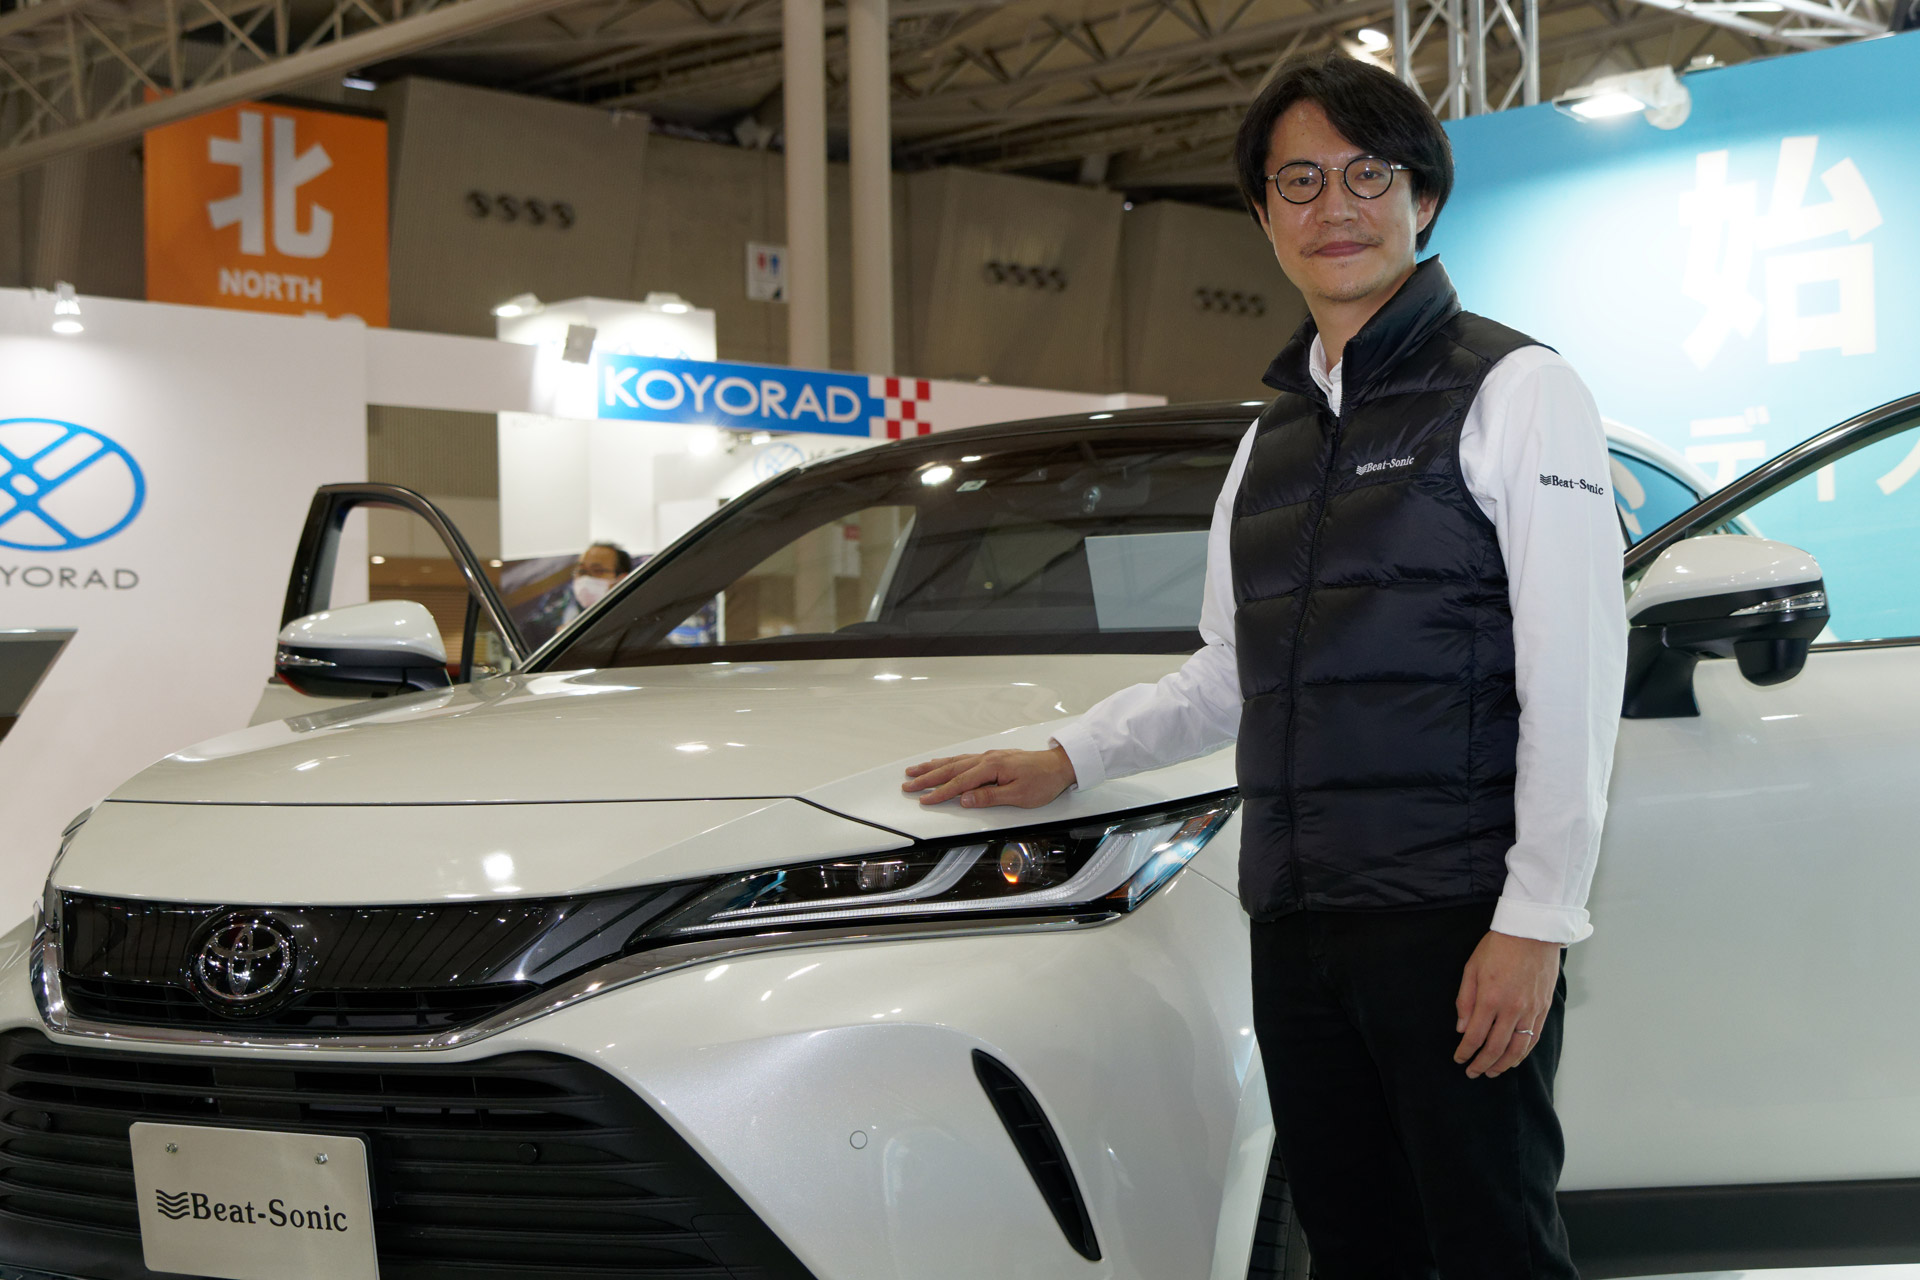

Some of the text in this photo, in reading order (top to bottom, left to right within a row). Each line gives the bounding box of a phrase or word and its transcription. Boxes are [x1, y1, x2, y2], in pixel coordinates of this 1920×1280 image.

[208, 111, 332, 258] 北
[1678, 136, 1883, 371] 始
[219, 268, 322, 304] NORTH
[605, 366, 862, 423] KOYORAD
[1366, 456, 1415, 473] Beat-Sonic
[191, 1192, 348, 1232] Beat-Sonic
